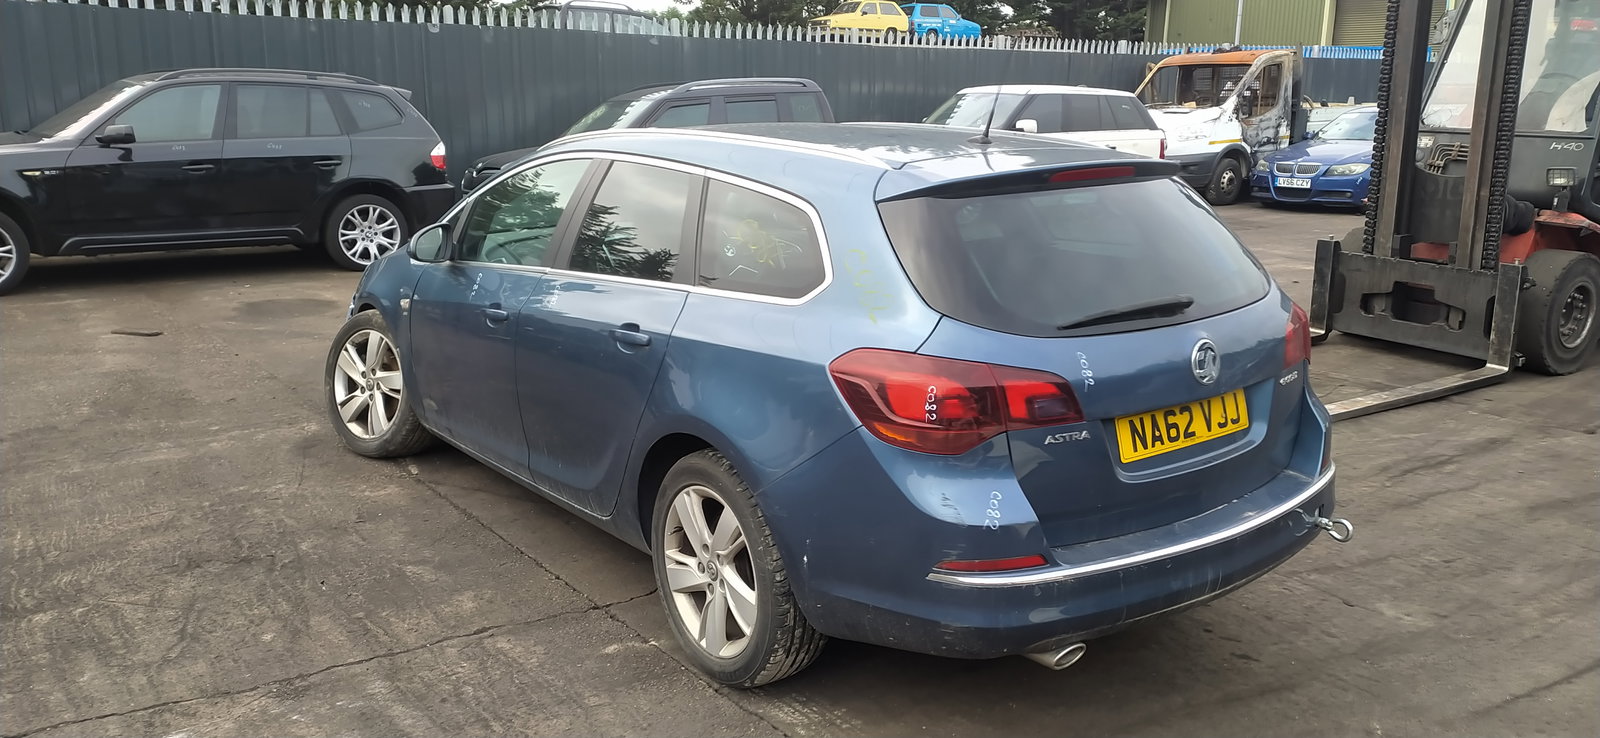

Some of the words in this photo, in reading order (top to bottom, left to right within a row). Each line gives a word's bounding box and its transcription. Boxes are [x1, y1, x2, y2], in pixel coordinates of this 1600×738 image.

[924, 385, 937, 423] C082
[1128, 405, 1197, 453] NA62
[1198, 392, 1241, 433] VJJ
[1043, 430, 1091, 445] ASTRA
[982, 491, 1002, 530] C082
